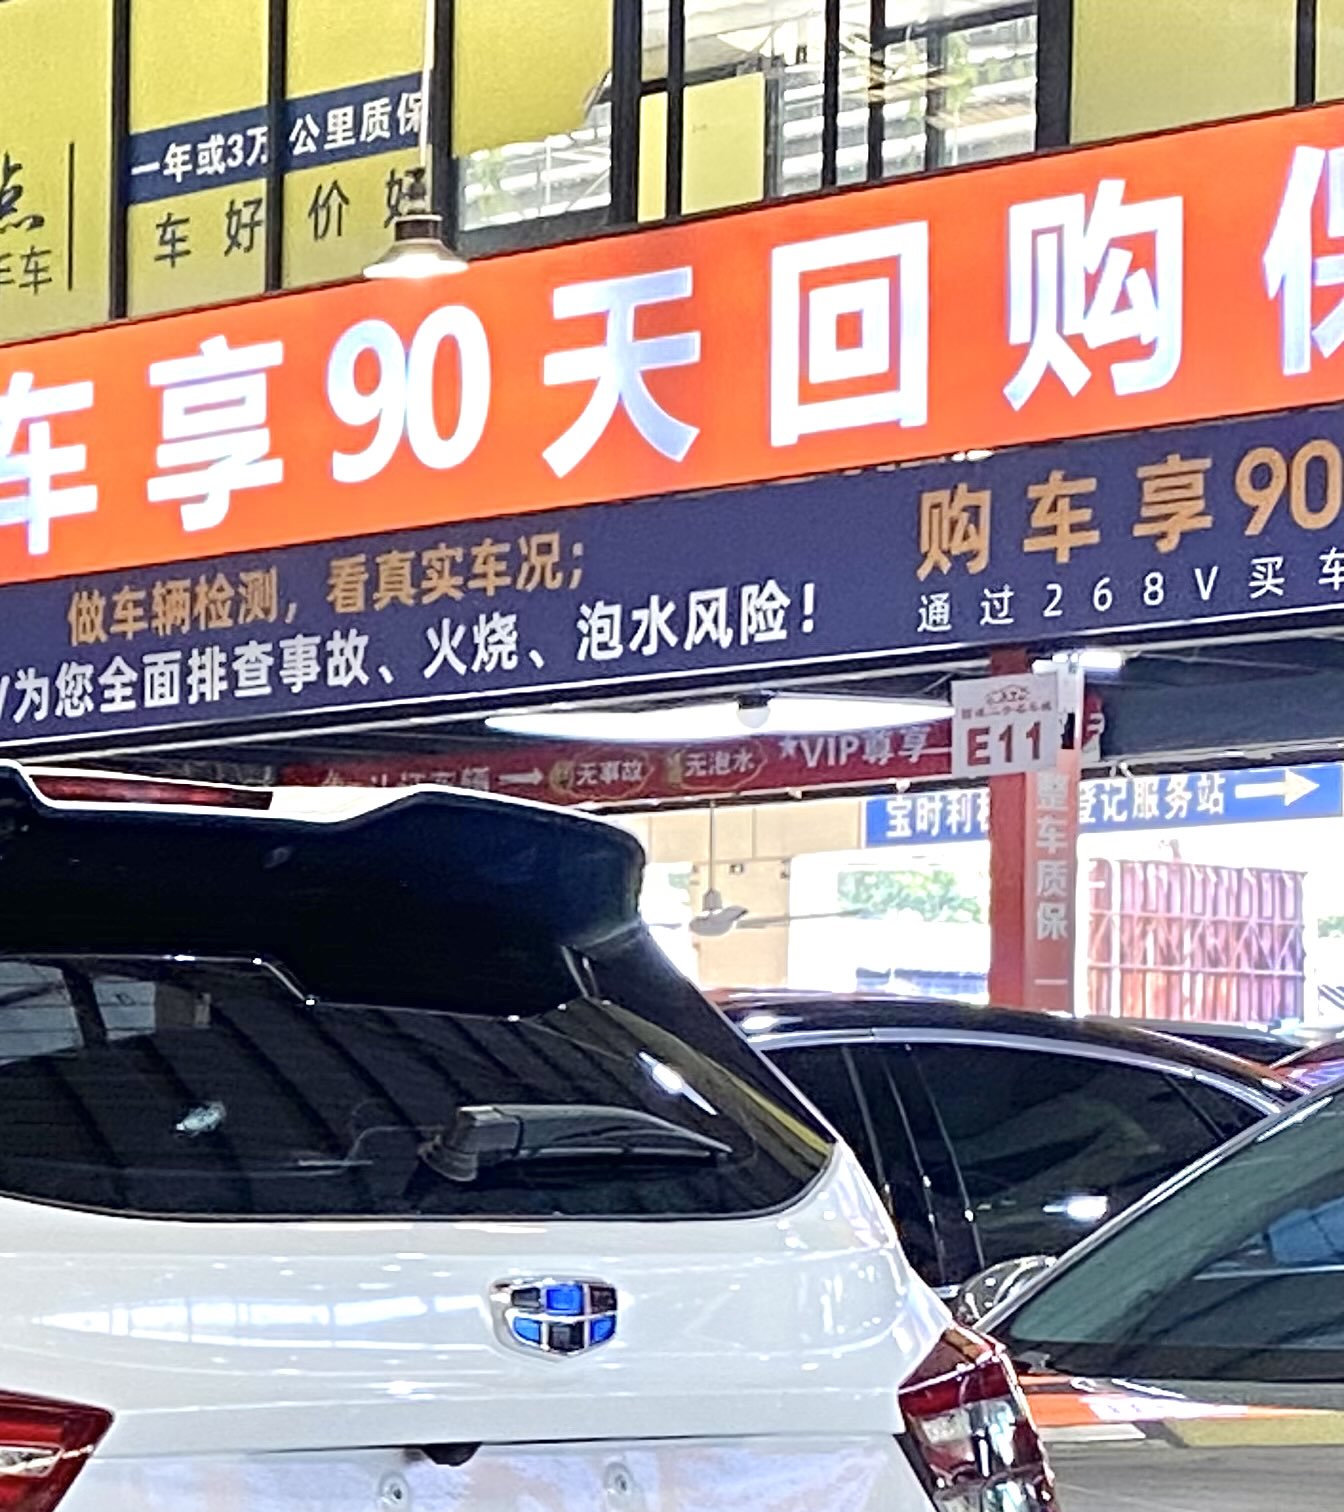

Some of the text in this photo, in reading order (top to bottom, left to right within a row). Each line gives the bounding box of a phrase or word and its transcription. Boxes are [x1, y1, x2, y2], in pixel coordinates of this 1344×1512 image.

[915, 438, 1344, 582] 购车享90
[967, 721, 1041, 766] E11
